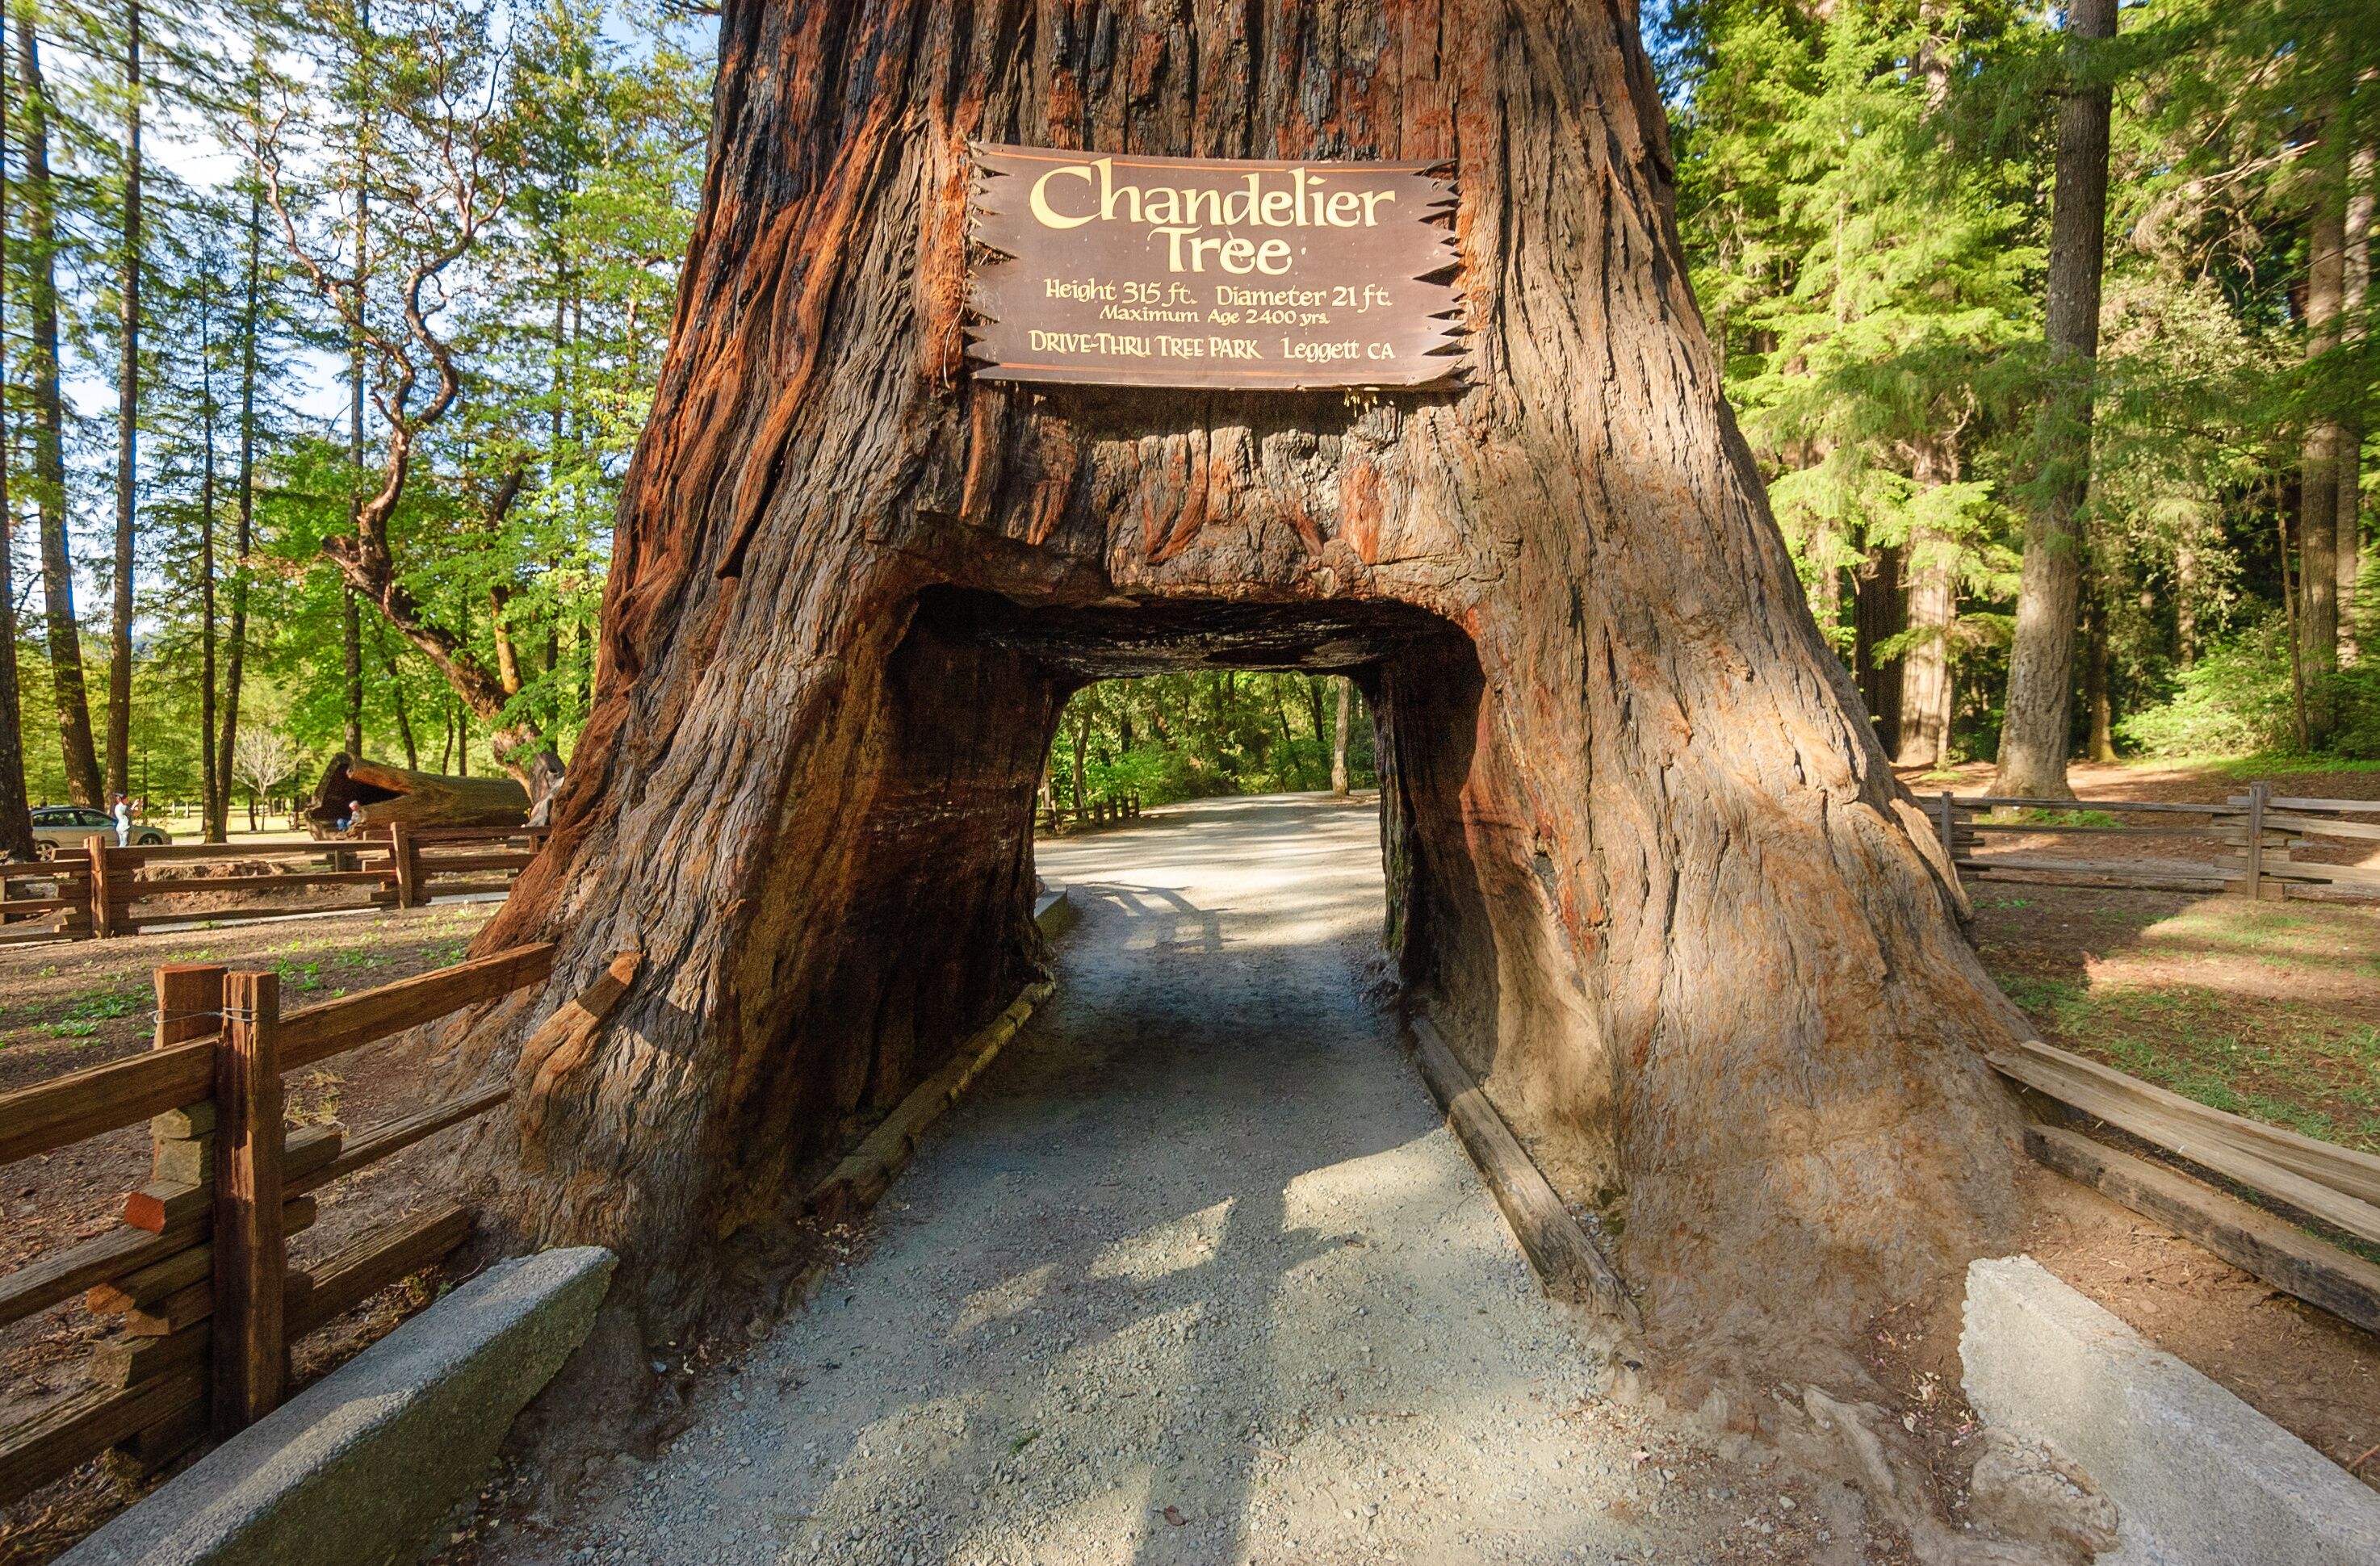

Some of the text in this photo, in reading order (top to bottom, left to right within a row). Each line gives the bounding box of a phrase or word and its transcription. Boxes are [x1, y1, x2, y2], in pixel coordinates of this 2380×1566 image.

[1029, 157, 1396, 229] Chandelier
[1147, 224, 1293, 275] Tree
[1044, 278, 1393, 313] Height 315 ft. Diameter 21 ft.
[1099, 304, 1330, 327] Maximum Age 2400 yrs.
[1028, 329, 1396, 363] DRIVE-THRU TREE PARK Leggett CA
